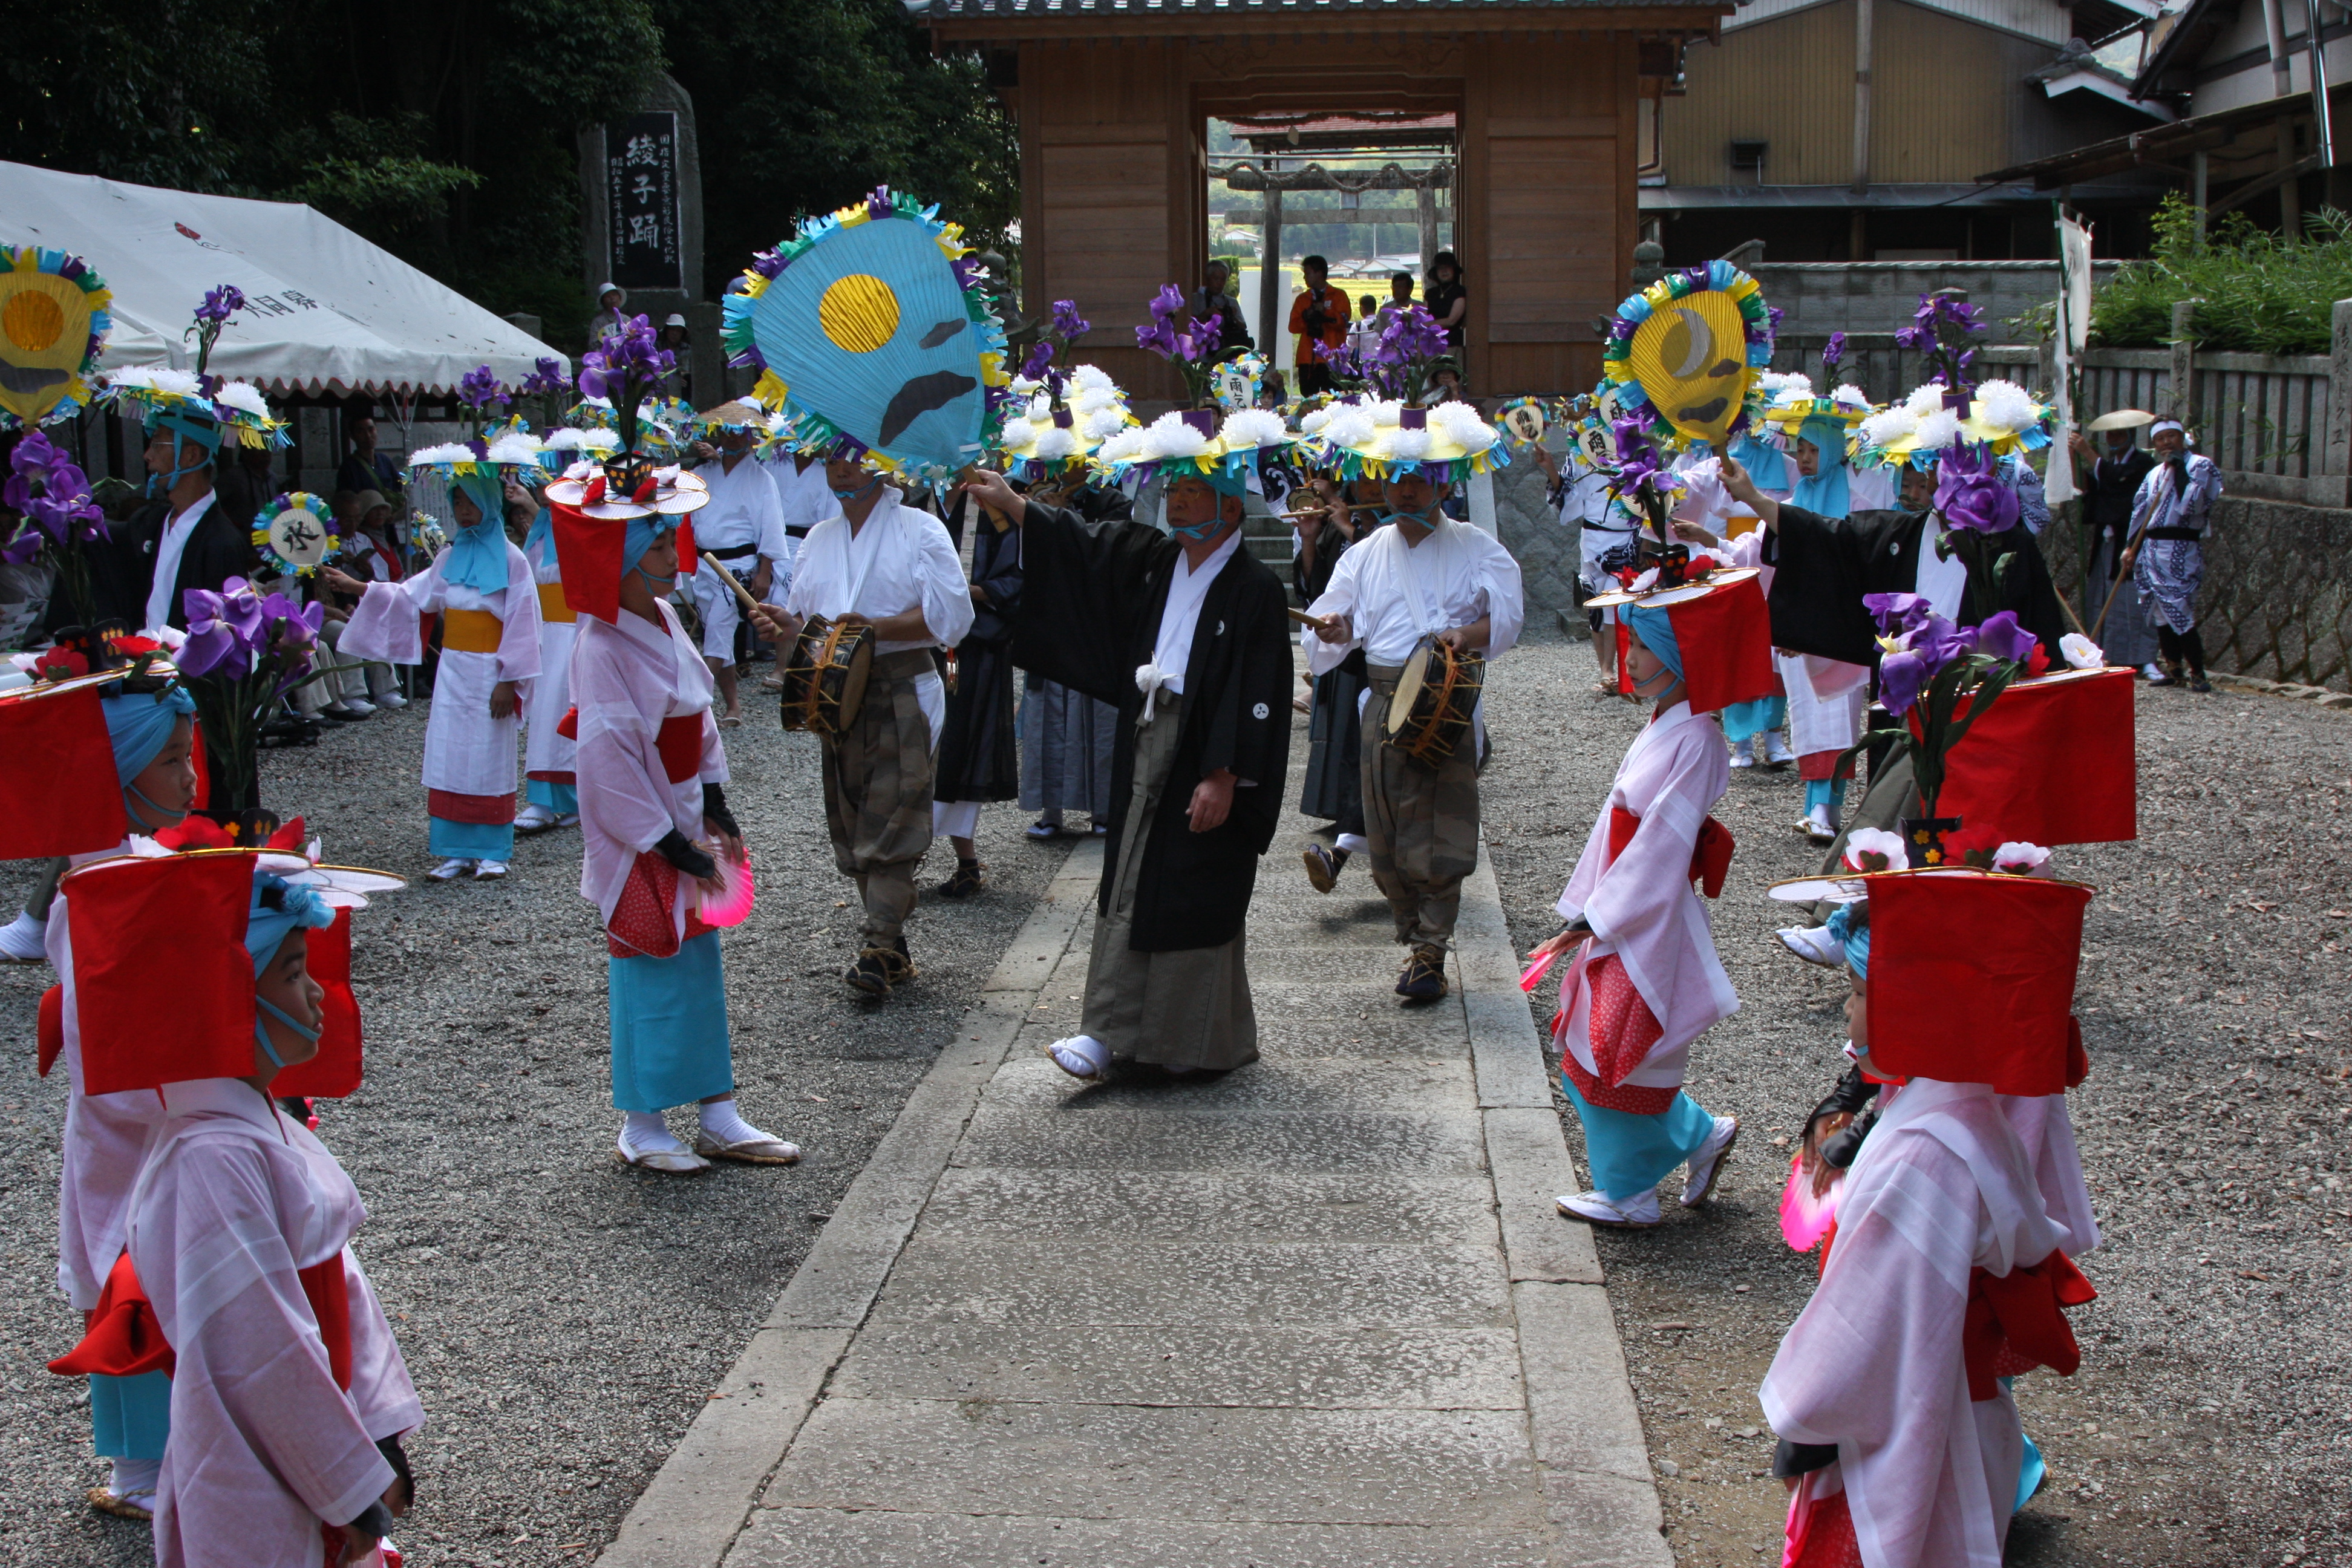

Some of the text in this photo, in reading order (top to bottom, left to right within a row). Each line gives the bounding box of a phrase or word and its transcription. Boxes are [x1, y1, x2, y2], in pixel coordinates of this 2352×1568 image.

[626, 133, 659, 249] 綾子踊
[282, 520, 321, 554] 水
